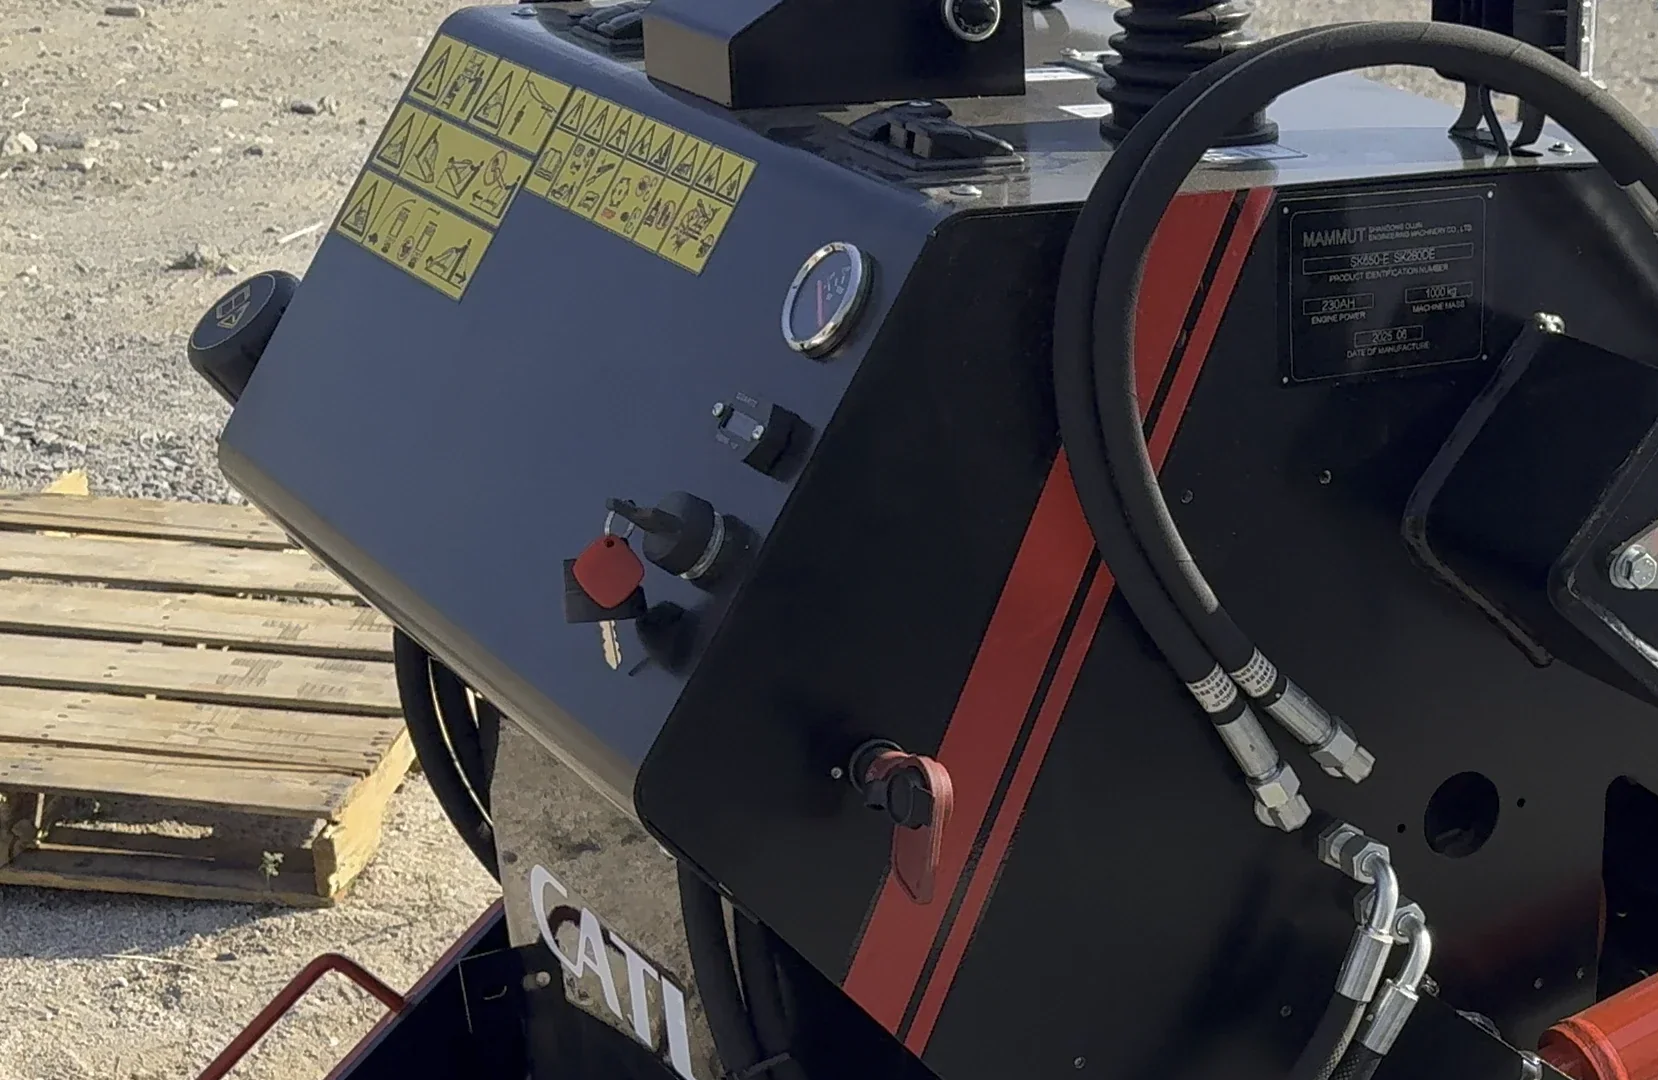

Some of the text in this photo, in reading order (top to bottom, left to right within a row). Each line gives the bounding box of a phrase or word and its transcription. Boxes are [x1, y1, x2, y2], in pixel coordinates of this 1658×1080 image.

[1303, 227, 1366, 247] MAMMUT
[1368, 230, 1410, 242] ENGINEERING
[1410, 227, 1446, 237] MACHINERY
[1329, 263, 1449, 283] PRODUCT IDENTIFICATION NUMBER
[1426, 286, 1446, 298] 1000
[1322, 297, 1356, 312] 230AH
[1412, 299, 1466, 313] MACHINE MASS
[1311, 310, 1366, 325] ENGINE POWER
[1346, 340, 1431, 359] DATE OF MANUFACTURE
